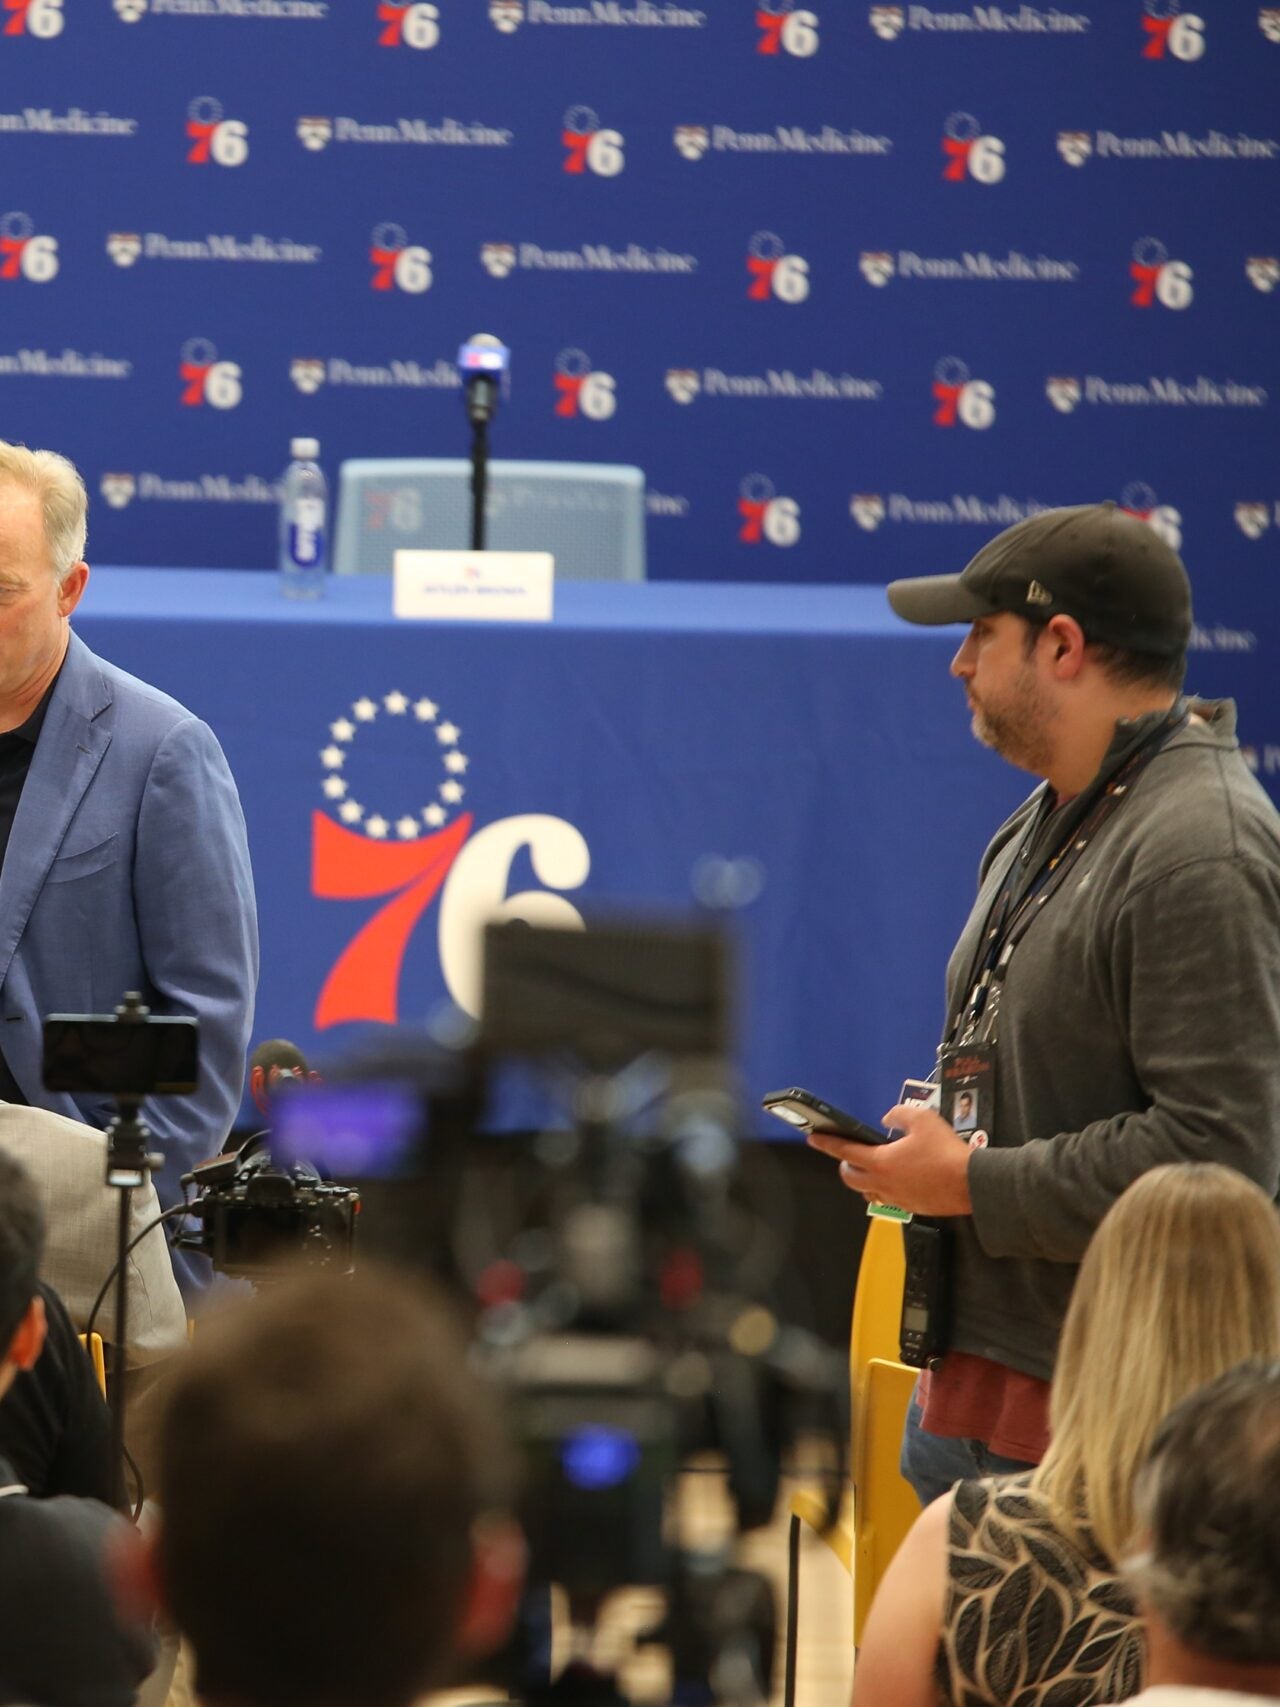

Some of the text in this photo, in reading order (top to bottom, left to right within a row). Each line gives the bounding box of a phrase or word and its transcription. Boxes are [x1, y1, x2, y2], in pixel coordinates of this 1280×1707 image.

[377, 0, 439, 50] 76
[756, 9, 818, 57] 76
[1143, 14, 1203, 60] 76
[186, 118, 248, 167] 76
[562, 129, 624, 176] 76
[943, 136, 1005, 183] 76
[370, 244, 432, 293] 76
[747, 254, 809, 303] 76
[1131, 262, 1192, 309] 76
[180, 359, 242, 409] 76
[554, 371, 615, 420] 76
[933, 380, 994, 429] 76
[739, 497, 800, 546] 76
[311, 810, 591, 1031] 76
